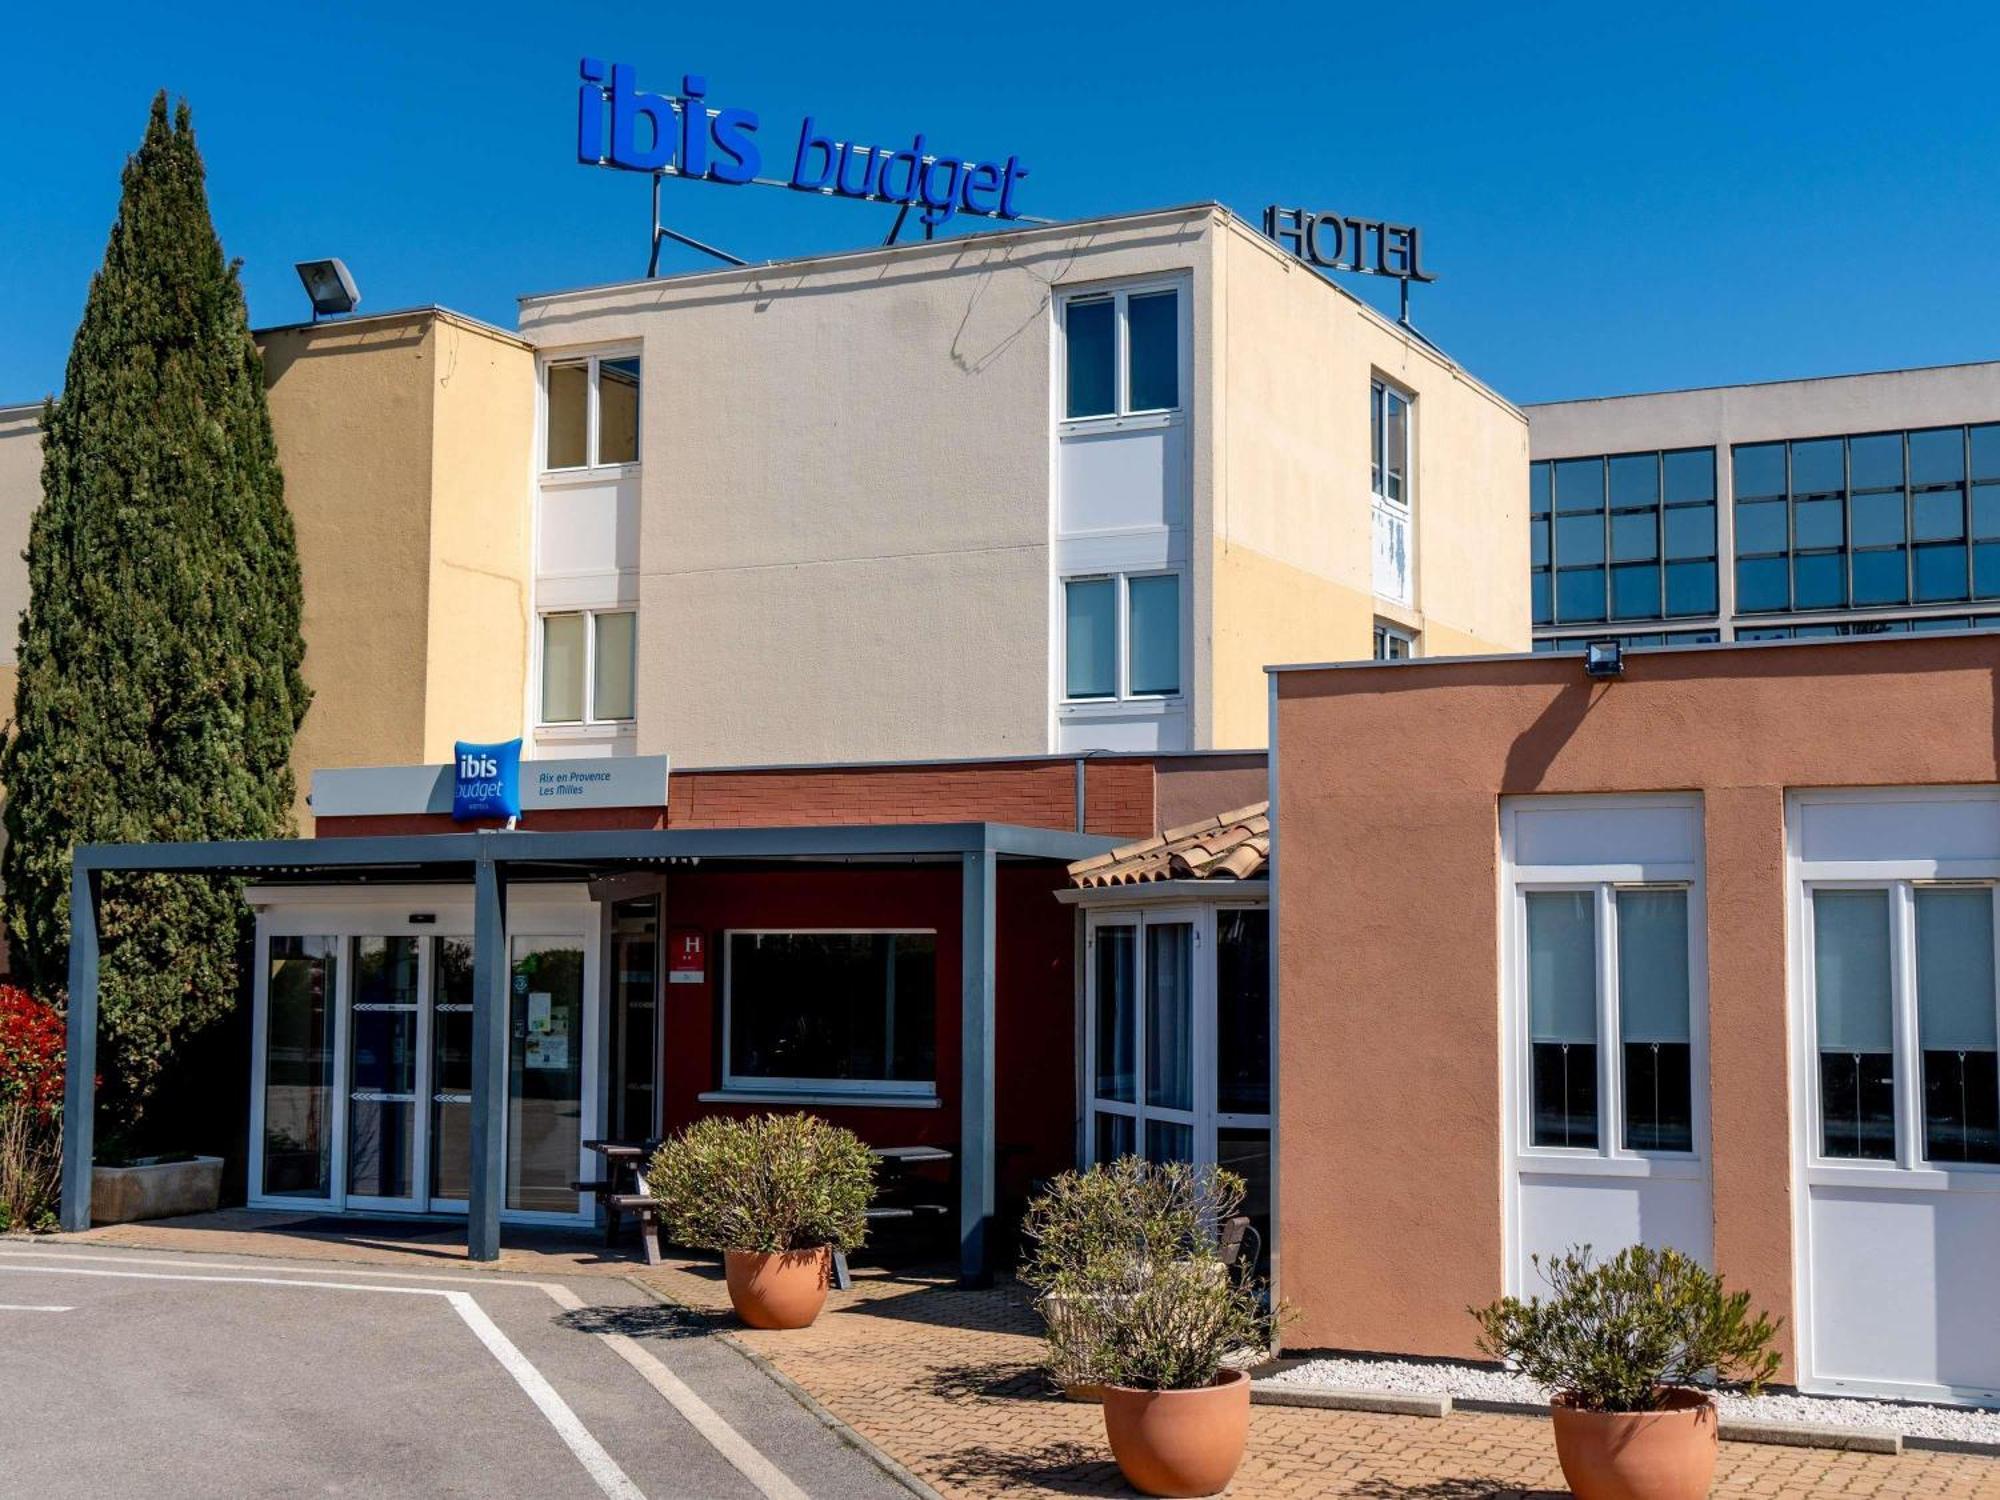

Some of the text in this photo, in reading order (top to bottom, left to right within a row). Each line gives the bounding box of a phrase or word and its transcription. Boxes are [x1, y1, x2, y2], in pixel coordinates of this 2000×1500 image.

[578, 57, 1030, 226] ibis budget
[1266, 205, 1438, 284] HOTEL
[461, 754, 497, 779] ibis
[539, 771, 611, 784] Aix en Provence
[539, 784, 584, 796] Les Milles
[685, 936, 700, 953] H
